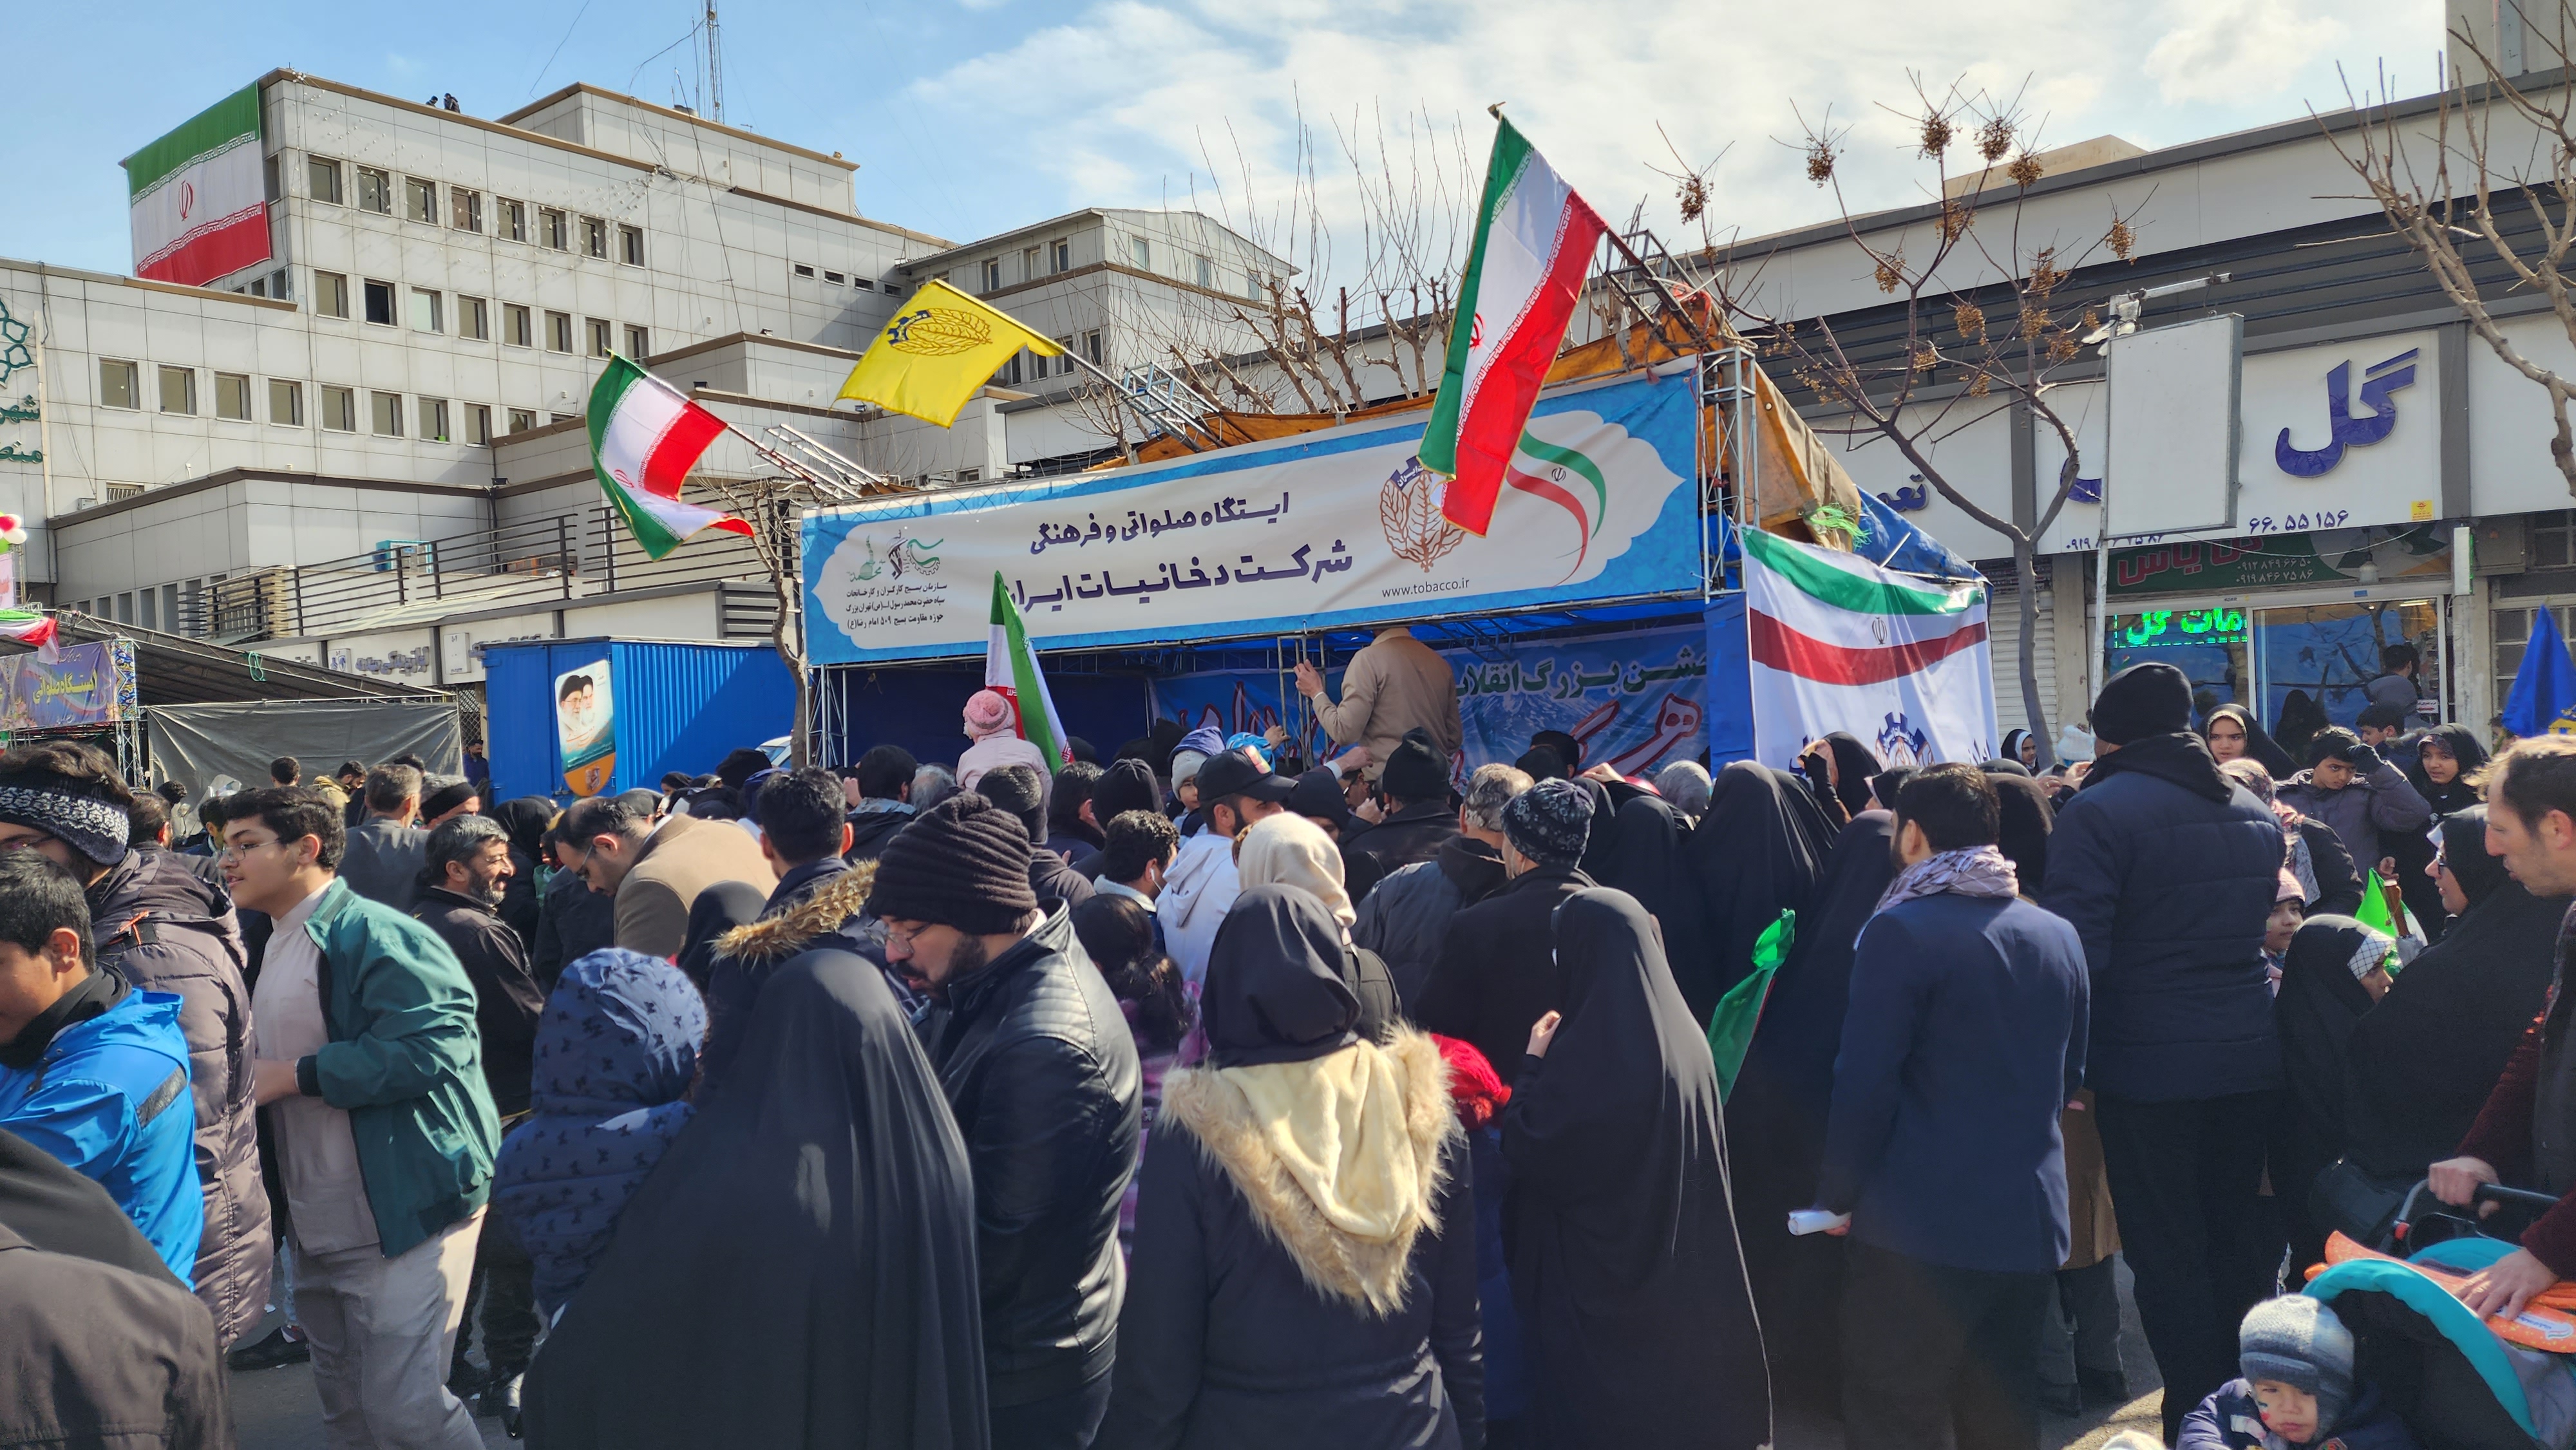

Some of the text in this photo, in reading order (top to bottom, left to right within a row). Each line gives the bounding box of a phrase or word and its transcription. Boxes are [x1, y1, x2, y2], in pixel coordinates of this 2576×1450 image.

[2275, 347, 2420, 478] گل
[1030, 492, 1289, 554] ایستگاه صلواتی و فرهنگی
[2285, 513, 2309, 531] ۵۵
[2316, 509, 2349, 529] ۱۵۶
[2066, 538, 2091, 551] ۰۹۱۹
[1234, 539, 1352, 583] شرکت
[2261, 559, 2281, 569] ۸۴۹
[2284, 558, 2297, 567] ۶۶
[1075, 556, 1230, 603] دخانیات
[1382, 578, 1470, 598] www.tobacco.ir
[2236, 569, 2314, 584] ۰۹۱۹ ۸۴۶ ۷۵ ۸۶
[61, 668, 98, 697] ایستگاه
[1522, 663, 1619, 698] بزرگ
